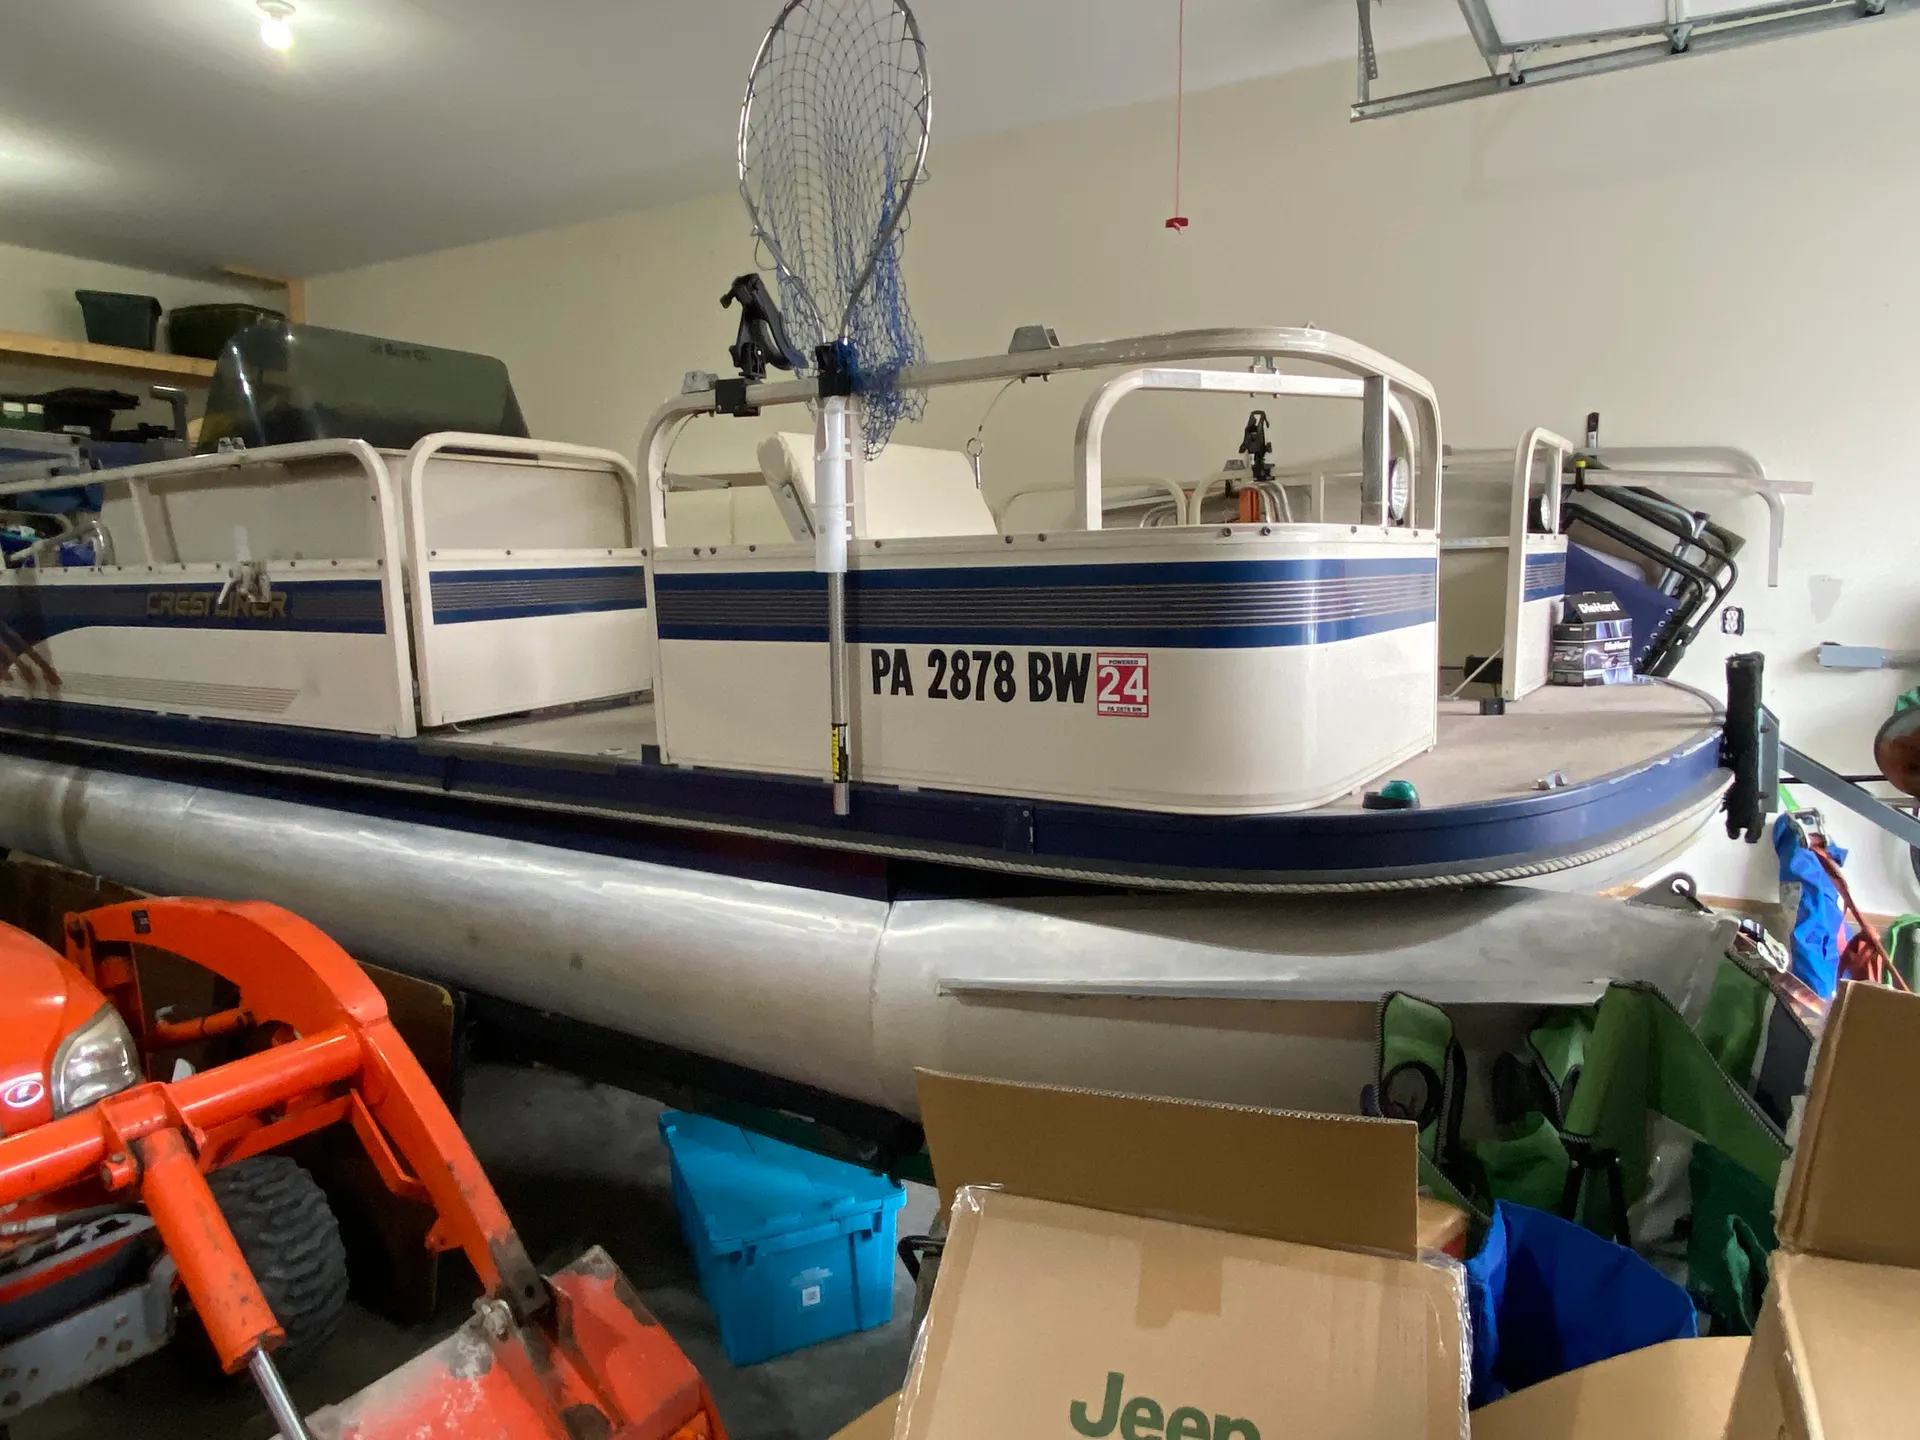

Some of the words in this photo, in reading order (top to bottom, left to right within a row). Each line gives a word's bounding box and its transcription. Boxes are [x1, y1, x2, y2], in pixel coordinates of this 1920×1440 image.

[1578, 601, 1620, 613] DieHard
[871, 648, 914, 696] PA
[927, 648, 1017, 703] 2878
[1028, 651, 1092, 704] BW
[1098, 666, 1148, 703] 24
